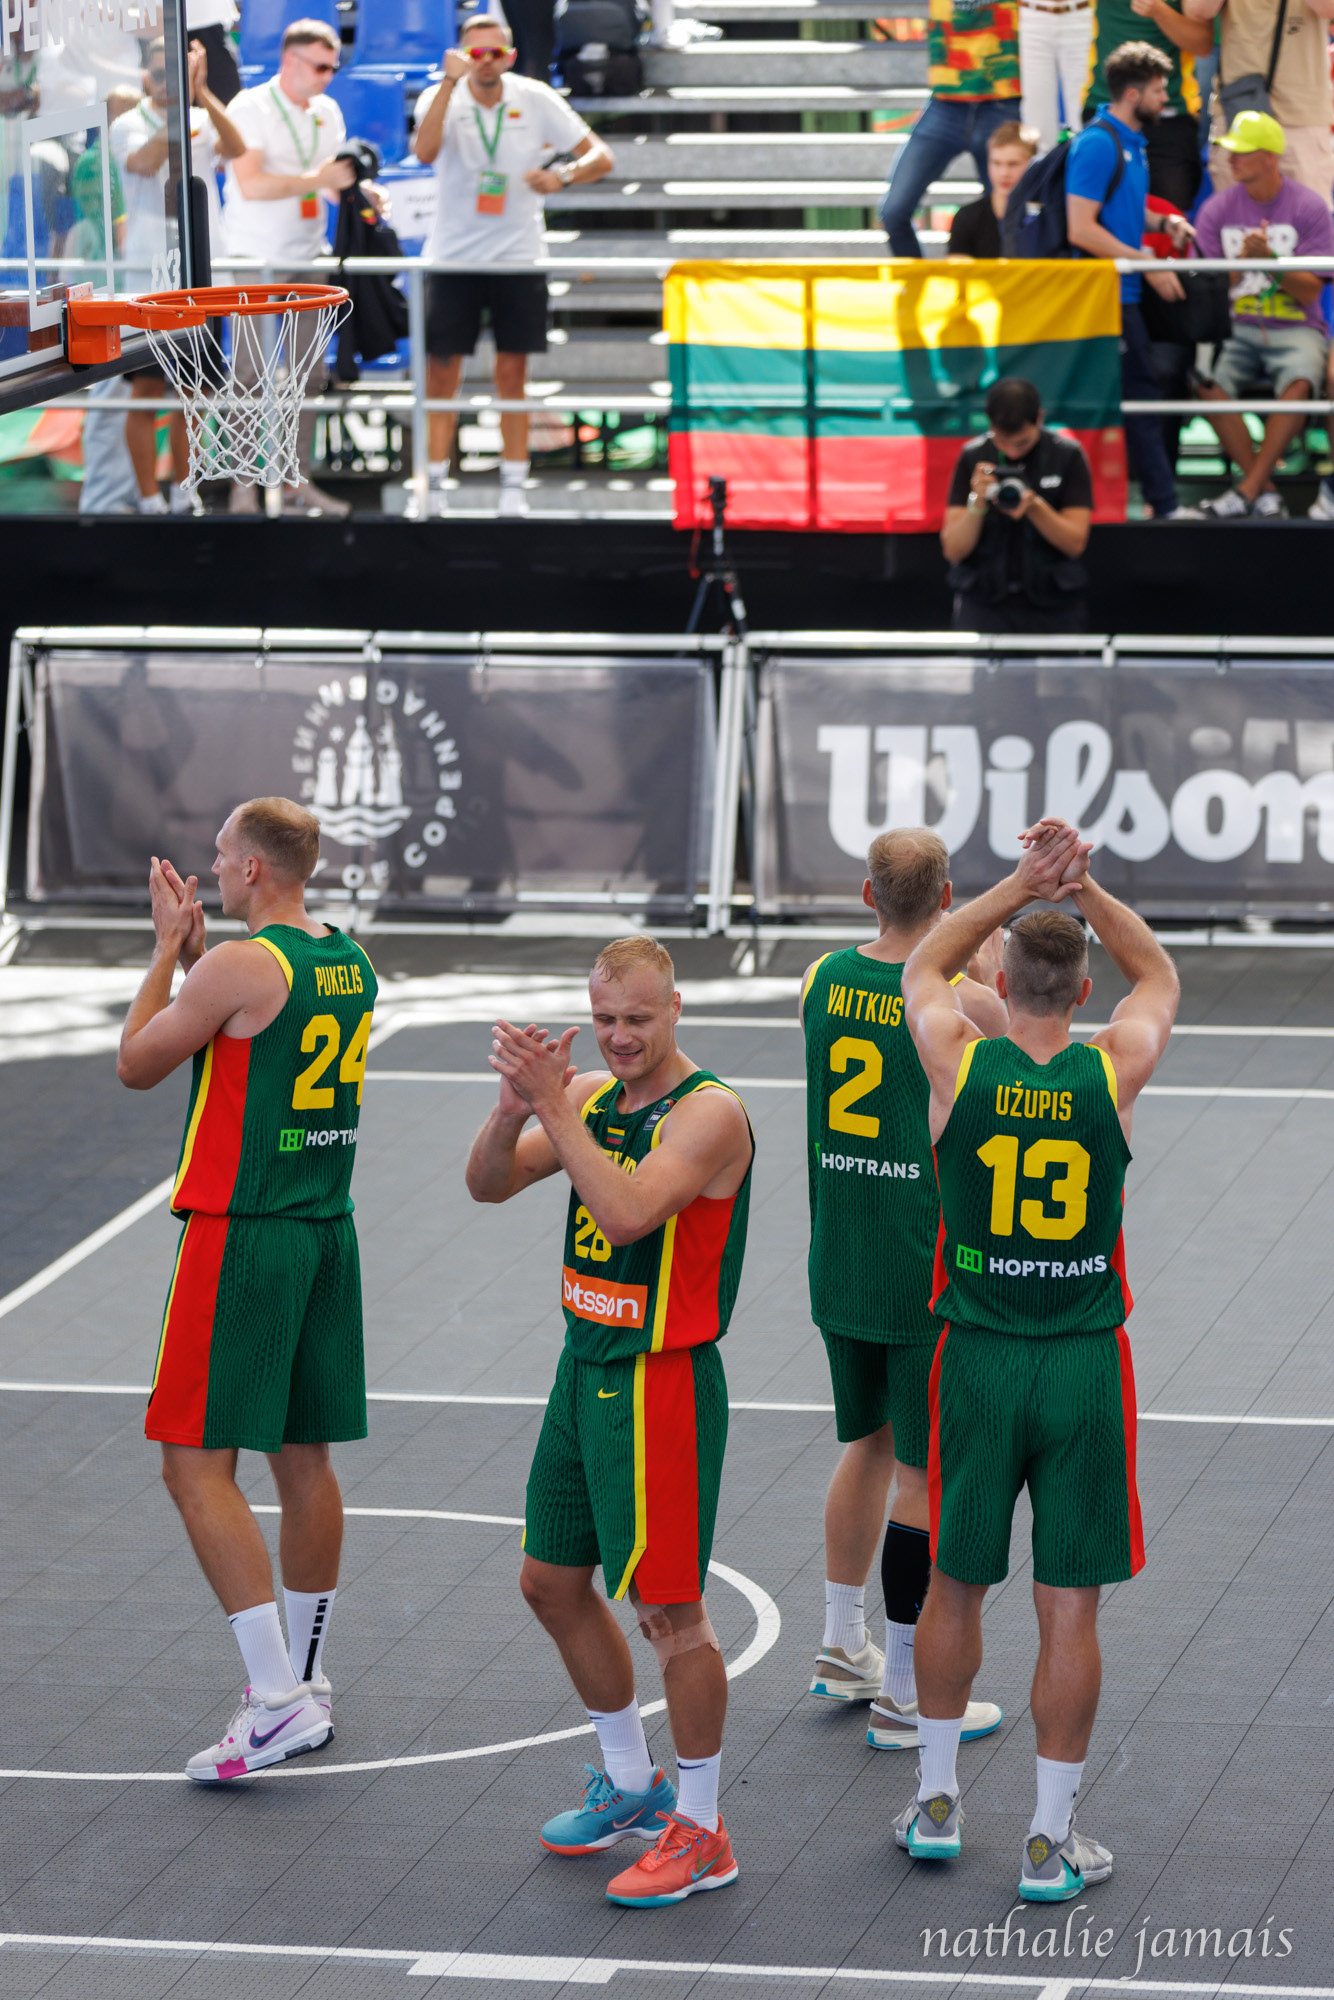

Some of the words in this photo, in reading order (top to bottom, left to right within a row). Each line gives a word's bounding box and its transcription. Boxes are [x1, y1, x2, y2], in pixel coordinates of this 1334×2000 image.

[817, 720, 1334, 862] Wilson
[314, 964, 364, 997] PUKELIS
[827, 983, 904, 1027] VAITKUS
[291, 1011, 374, 1110] 24
[828, 1035, 884, 1139] 2
[995, 1080, 1073, 1122] UŽUPIS
[821, 1152, 921, 1180] HOPTRANS
[976, 1134, 1091, 1241] 13
[989, 1254, 1108, 1278] HOPTRANS
